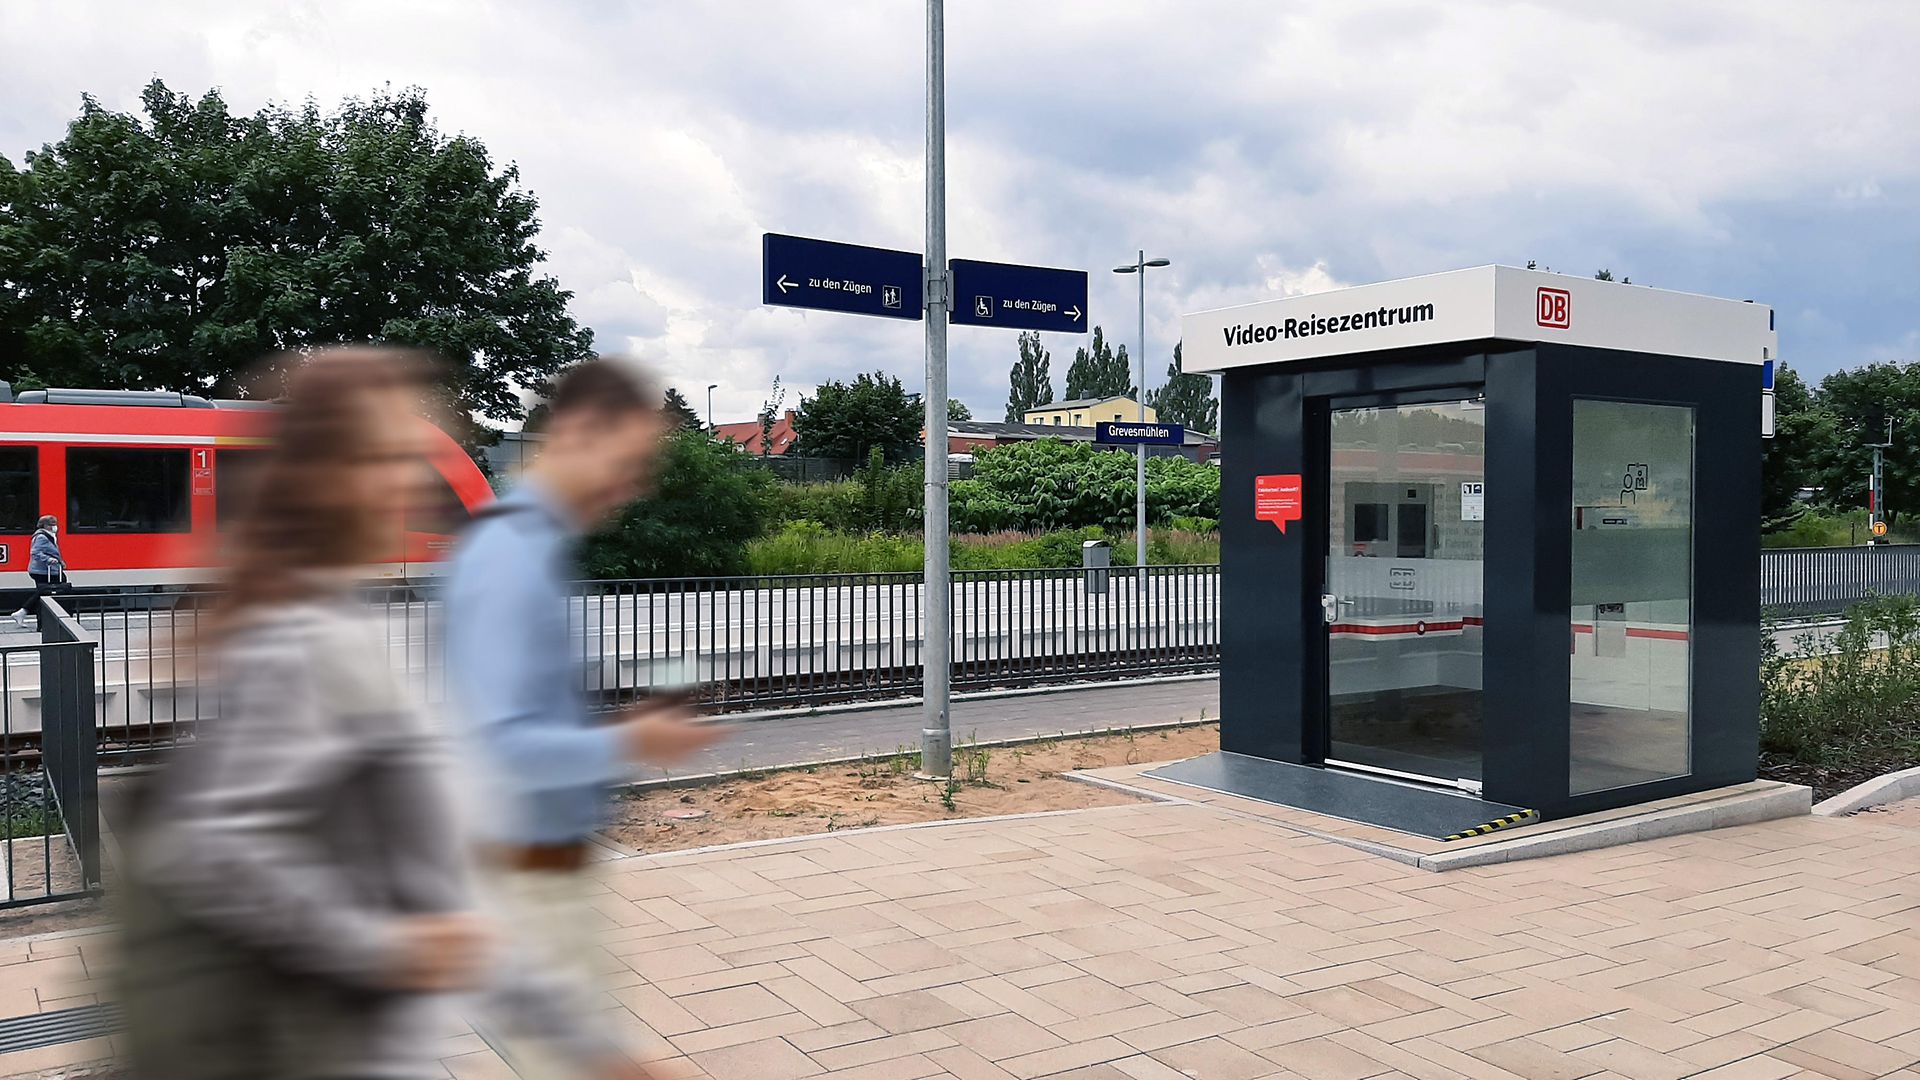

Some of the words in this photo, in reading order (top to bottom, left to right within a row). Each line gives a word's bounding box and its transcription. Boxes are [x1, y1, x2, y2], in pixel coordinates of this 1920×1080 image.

[808, 278, 820, 287] zu
[822, 277, 840, 289] den
[843, 280, 872, 294] Zügen
[1002, 299, 1013, 308] zu
[1014, 299, 1030, 309] den
[1031, 300, 1057, 313] Zügen
[1539, 292, 1568, 326] DB
[1223, 302, 1434, 347] Video-Reisezentrum
[1108, 425, 1169, 437] Grevesmühlen
[197, 450, 206, 468] 1
